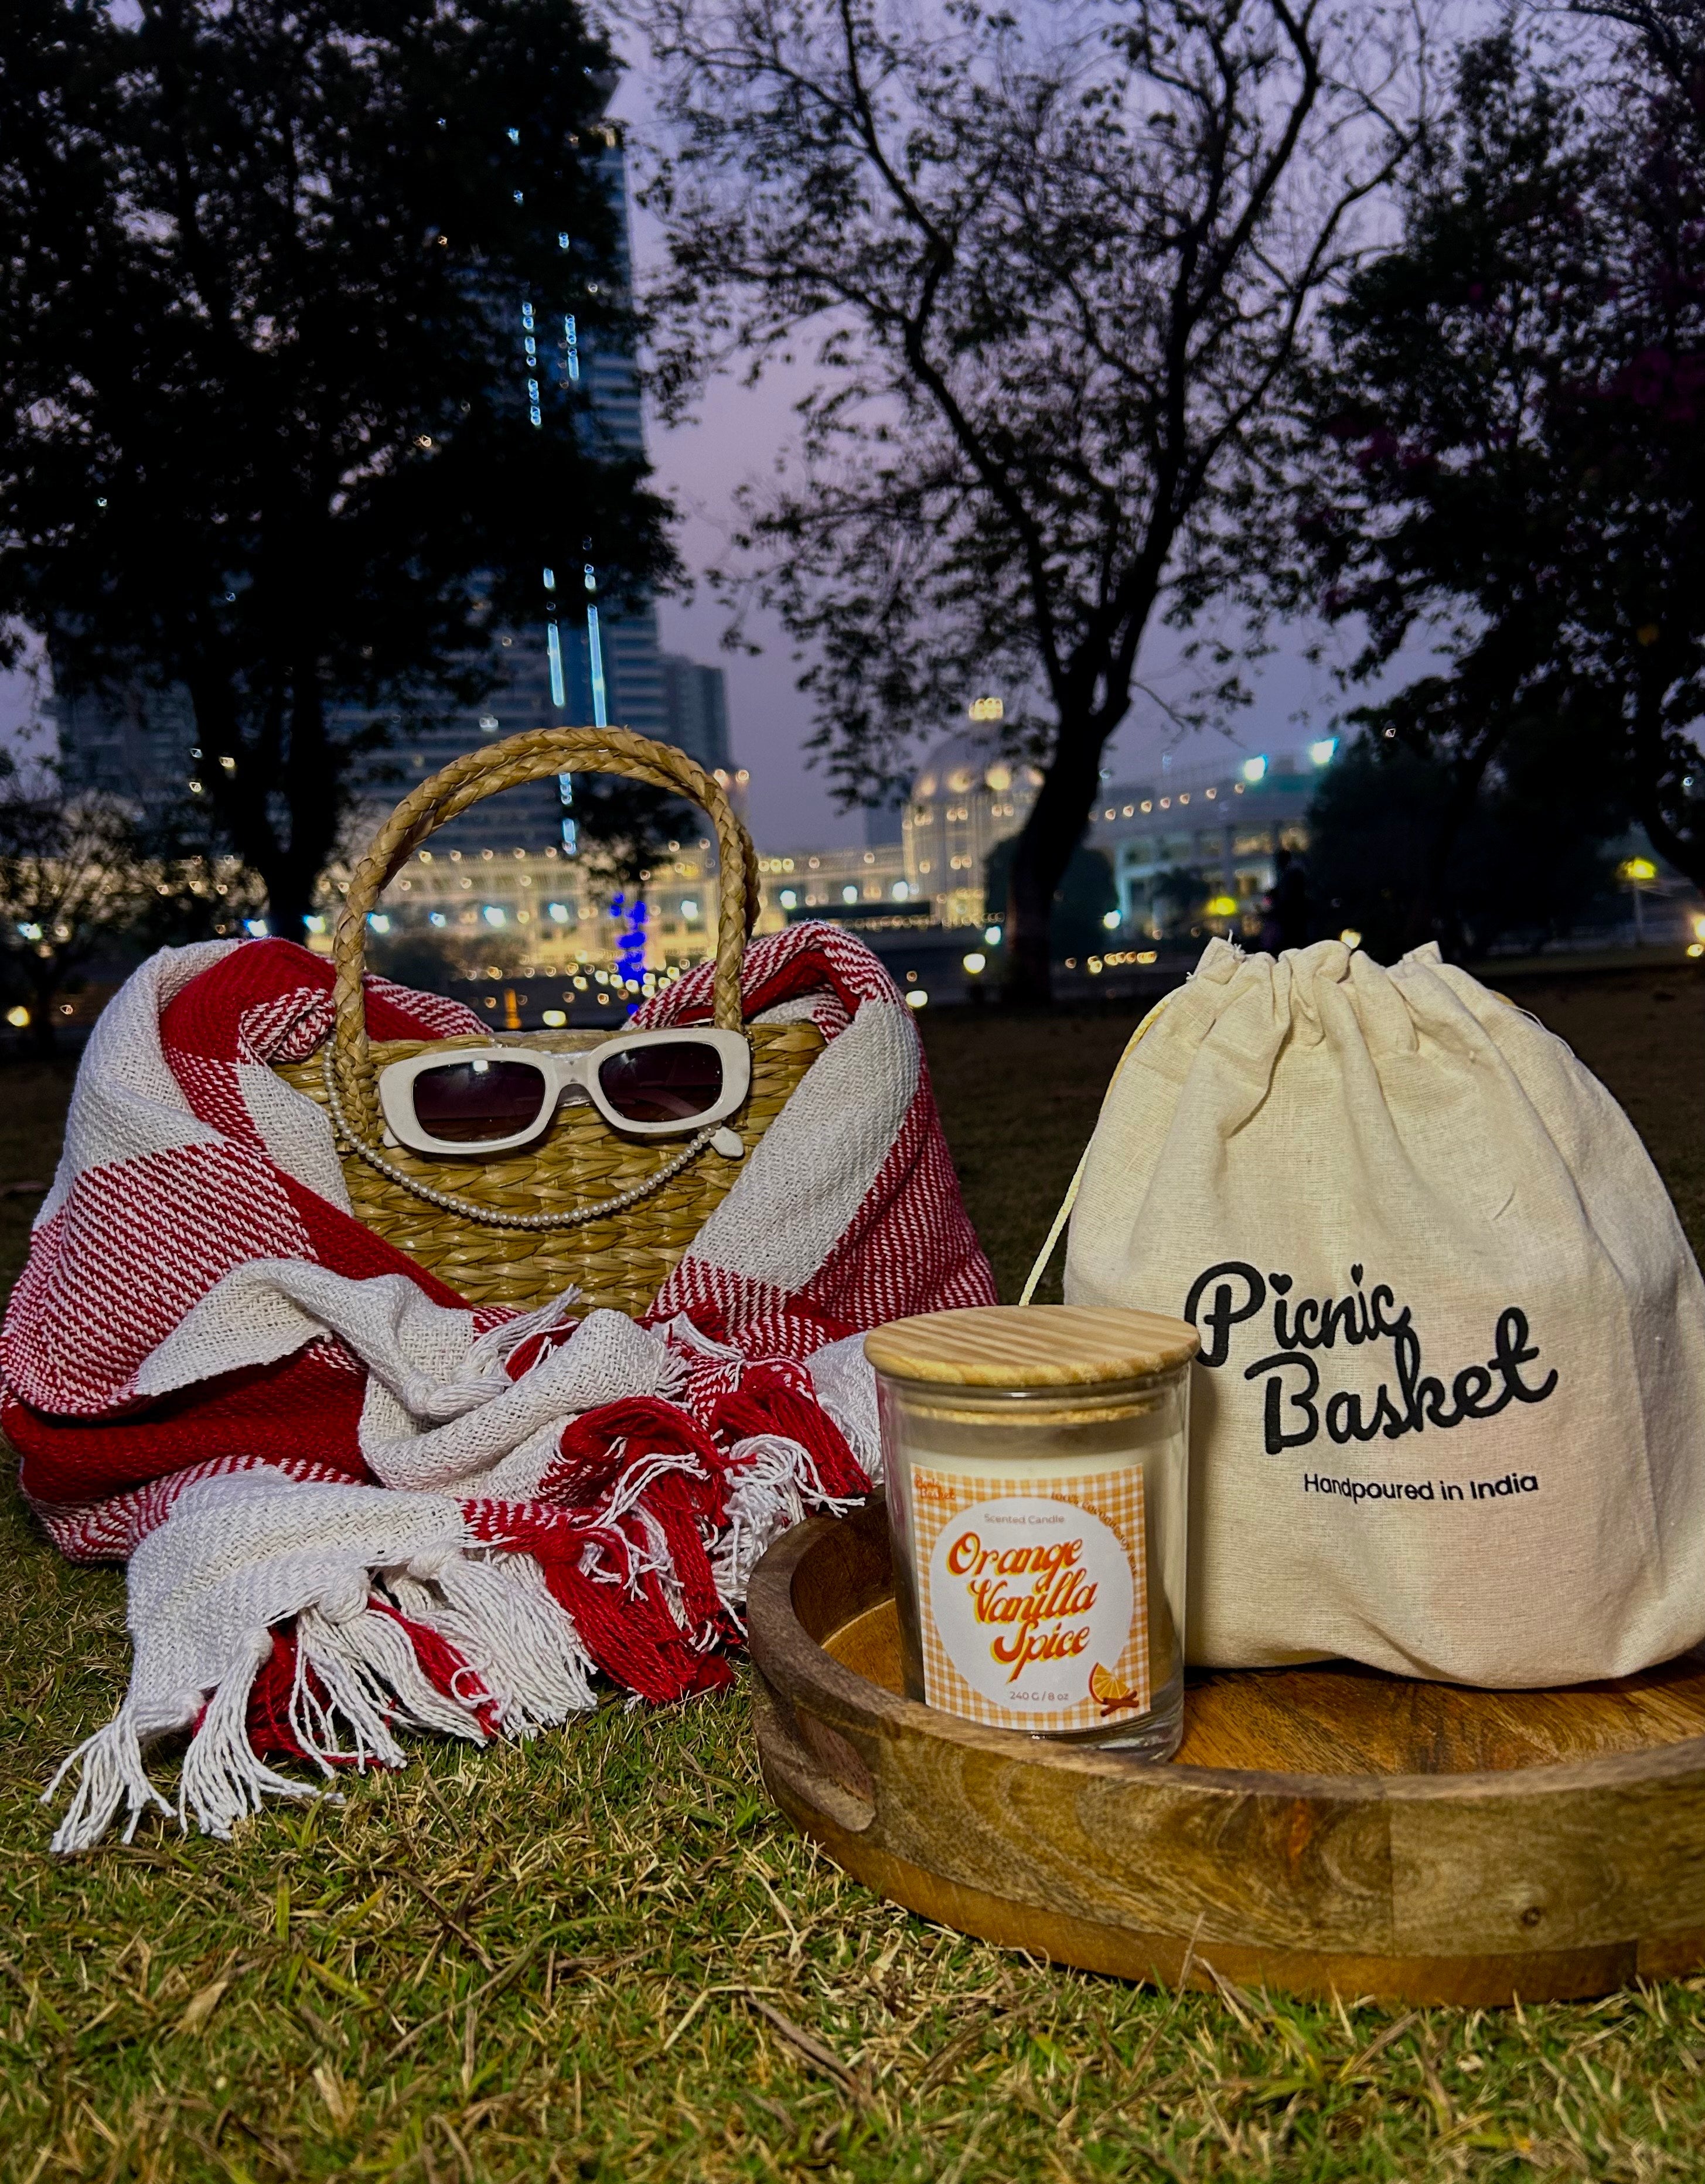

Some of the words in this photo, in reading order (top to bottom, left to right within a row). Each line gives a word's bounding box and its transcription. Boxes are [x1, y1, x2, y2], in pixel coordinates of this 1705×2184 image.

[1185, 1261, 1411, 1367] Picnic
[1244, 1306, 1559, 1455] Basket
[1304, 1473, 1435, 1504] Handpoured
[1440, 1480, 1464, 1500] in
[1470, 1472, 1539, 1500] India
[984, 1513, 1025, 1524] Scented
[1028, 1515, 1065, 1524] Candle
[947, 1531, 1083, 1593] Orange
[968, 1567, 1099, 1625] Vanilla
[990, 1618, 1090, 1685] Spice
[1010, 1691, 1029, 1701] 240
[1031, 1691, 1039, 1701] G
[1048, 1691, 1055, 1701] 8
[1057, 1693, 1069, 1701] oz
